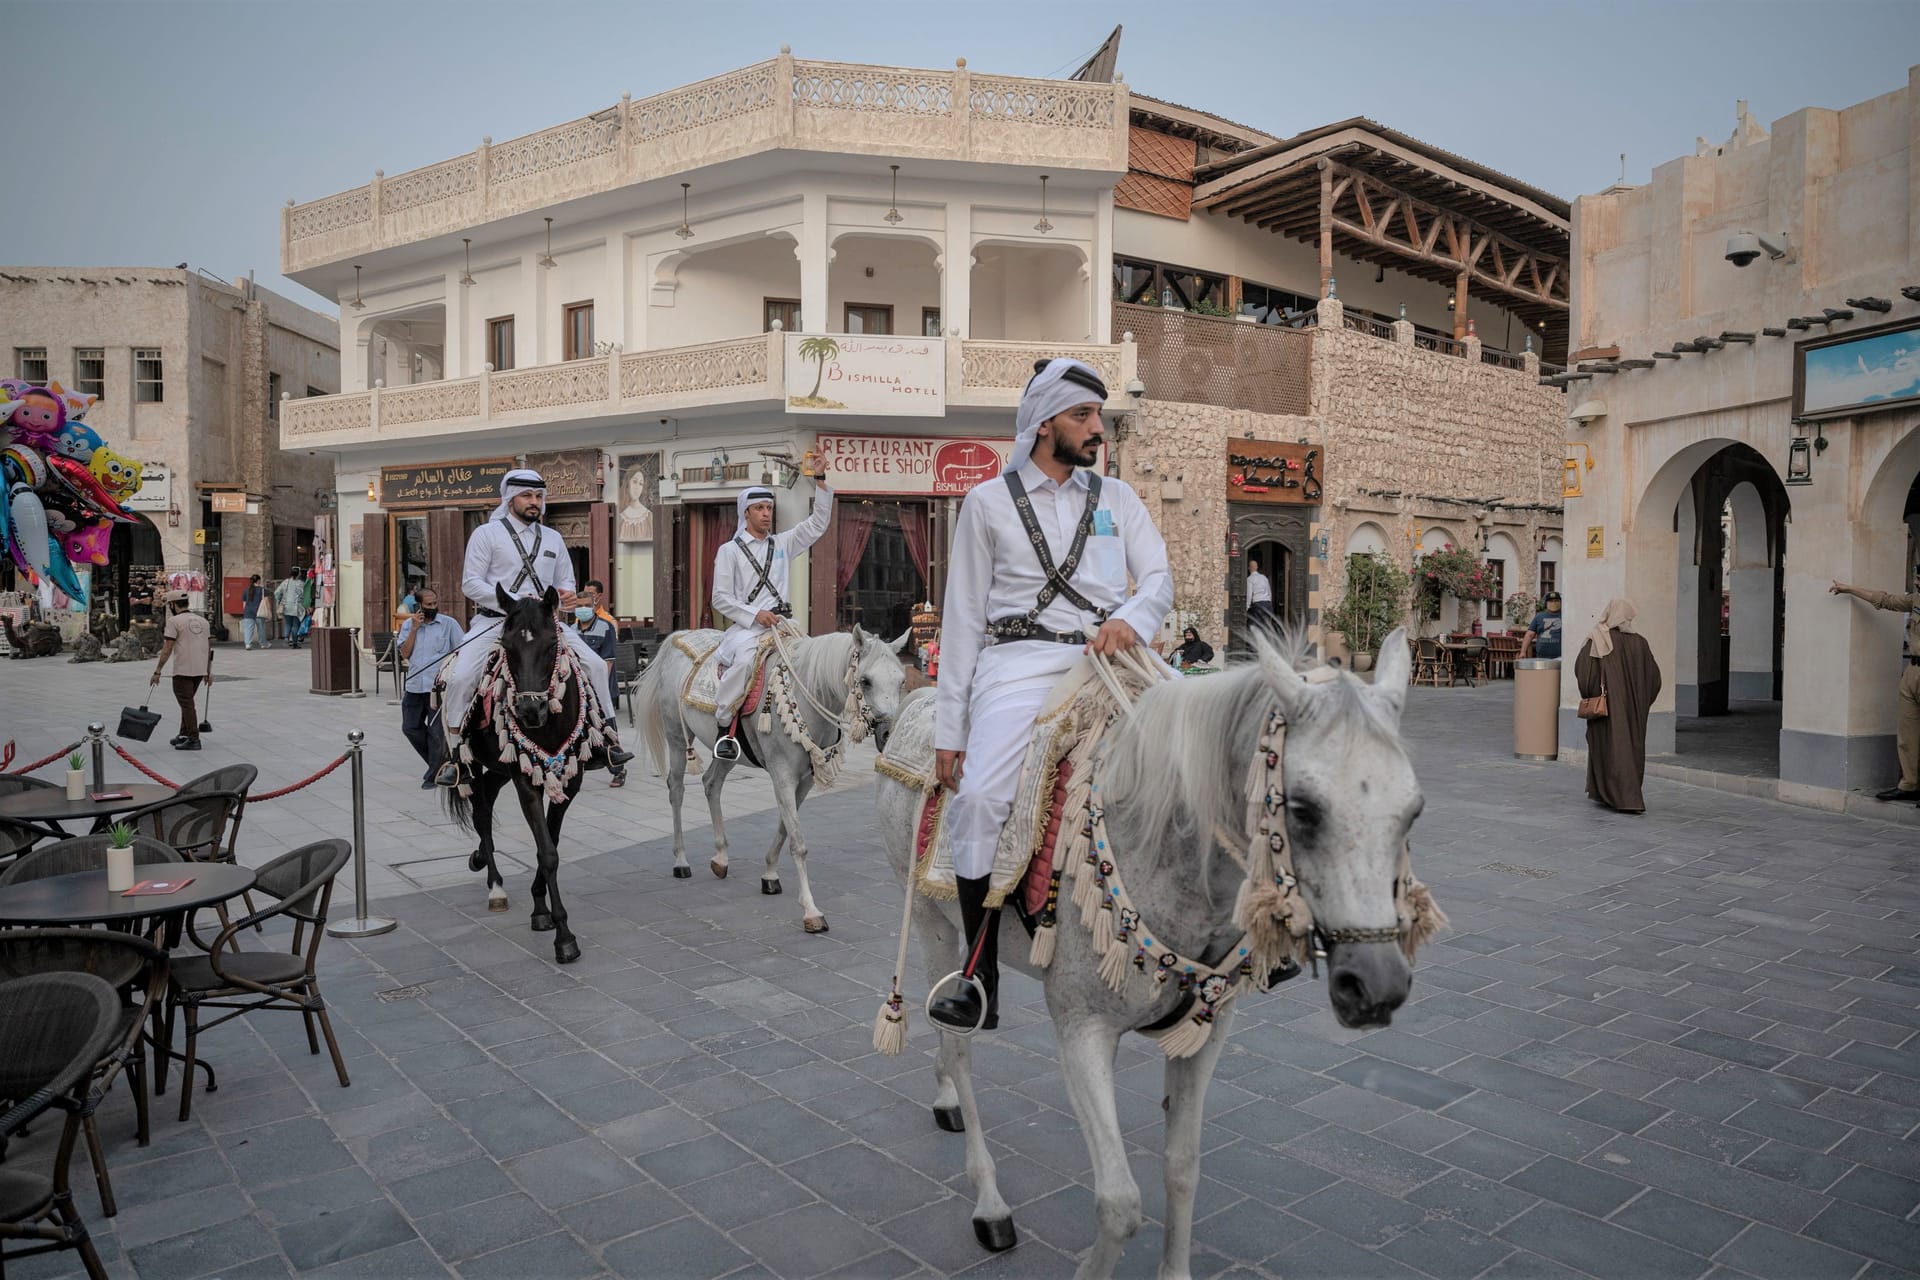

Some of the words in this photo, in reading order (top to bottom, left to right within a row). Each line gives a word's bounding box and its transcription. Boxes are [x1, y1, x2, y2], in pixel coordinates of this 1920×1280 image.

[827, 361, 901, 384] BISMILLA
[892, 386, 938, 395] HOTEL
[822, 438, 934, 457] RESTAURANT
[834, 456, 890, 474] COFFEE
[895, 458, 932, 474] SHOP
